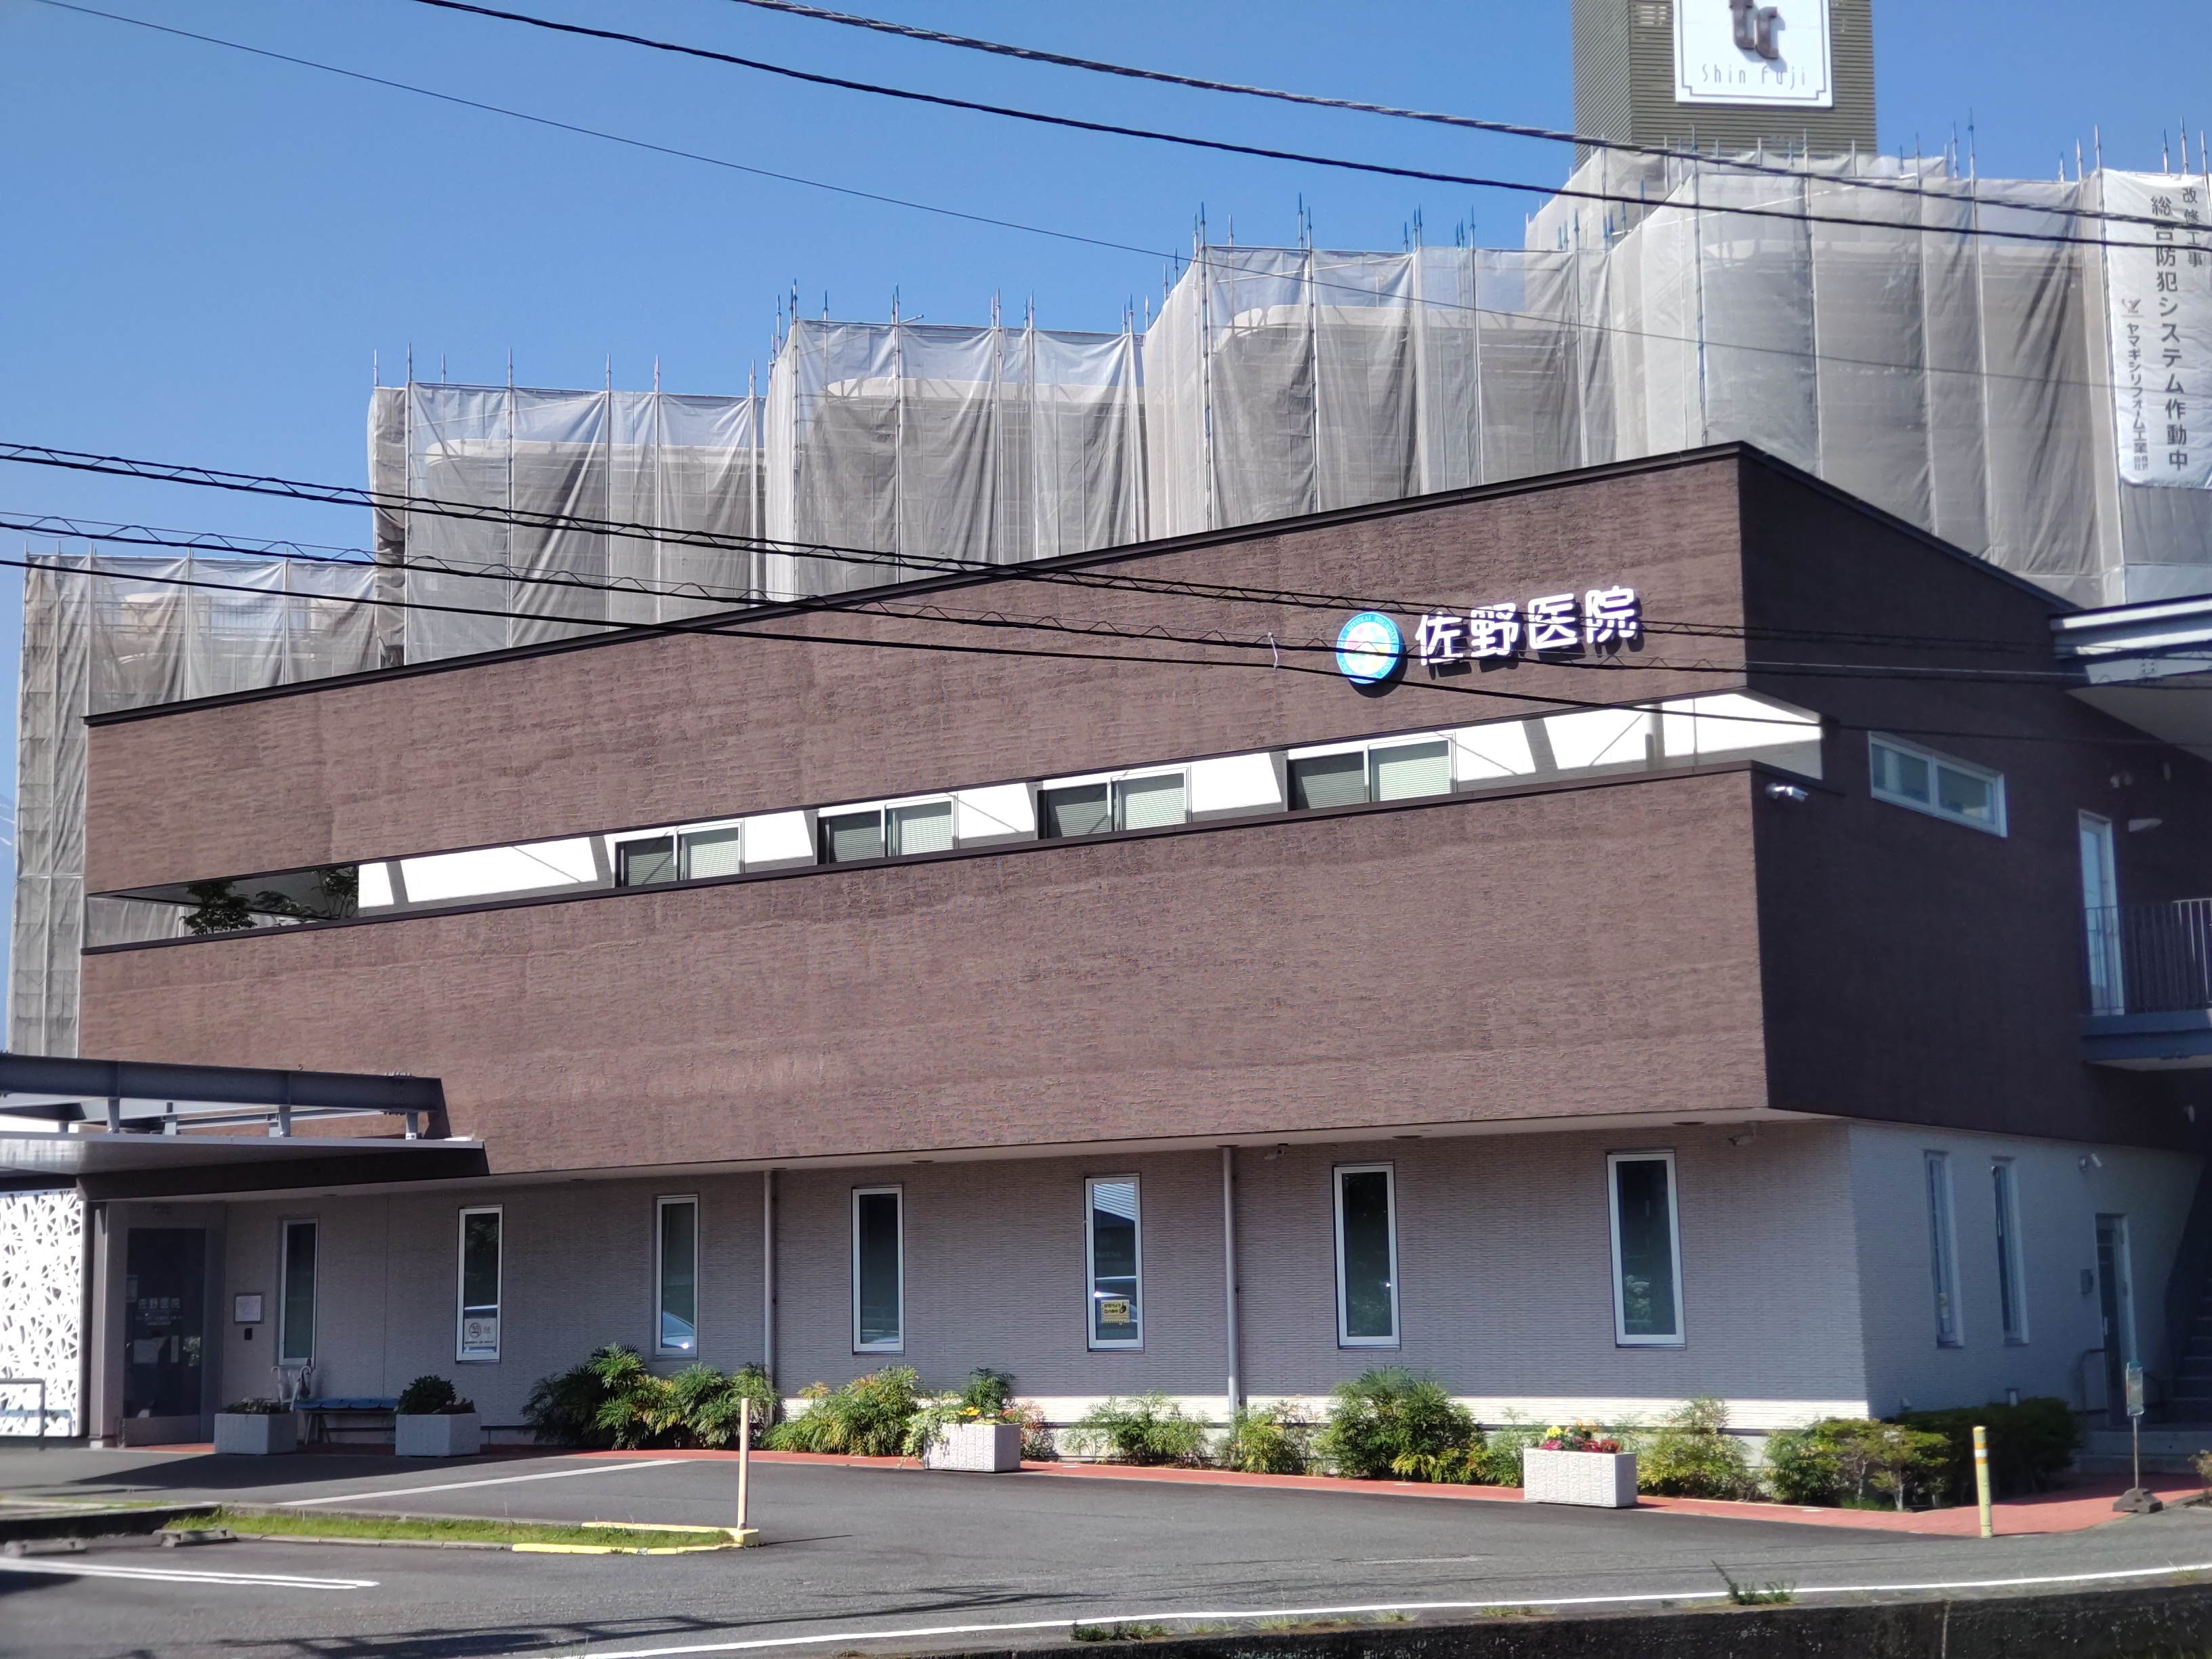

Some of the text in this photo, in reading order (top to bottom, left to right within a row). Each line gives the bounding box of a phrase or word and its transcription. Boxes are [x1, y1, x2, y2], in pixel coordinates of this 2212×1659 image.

[1702, 63, 1746, 85] Shin
[2182, 187, 2203, 268] 改修工事
[1415, 586, 1638, 666] 佐野医院
